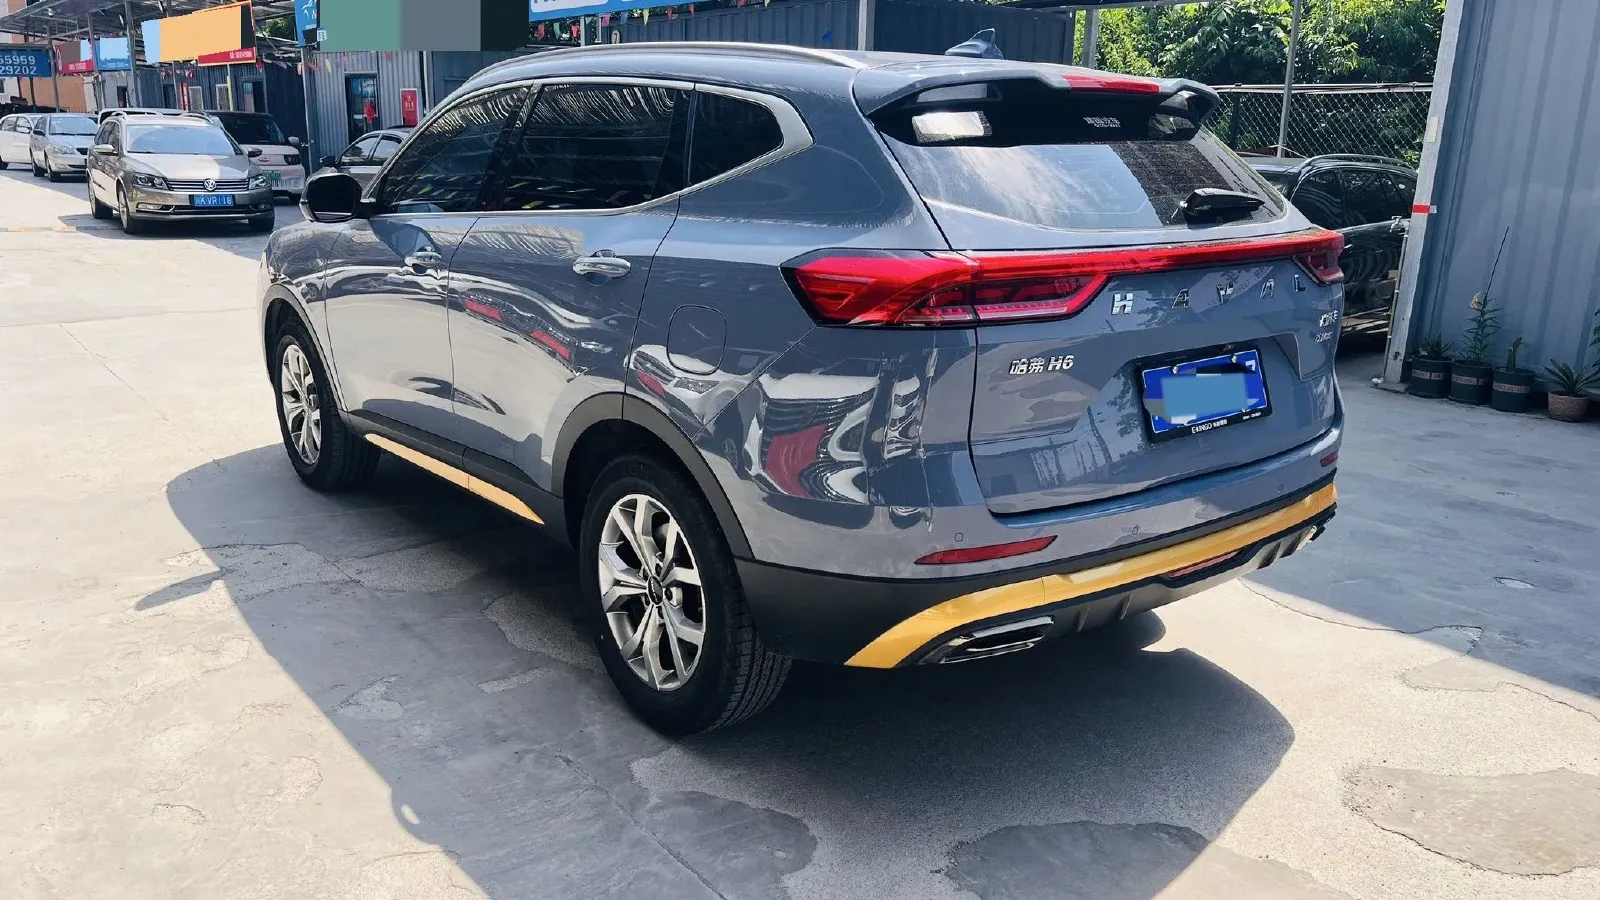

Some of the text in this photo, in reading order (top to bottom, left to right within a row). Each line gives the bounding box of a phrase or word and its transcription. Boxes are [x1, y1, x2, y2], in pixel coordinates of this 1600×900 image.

[0, 65, 38, 75] 29202
[1009, 354, 1075, 375] 哈弗 H6
